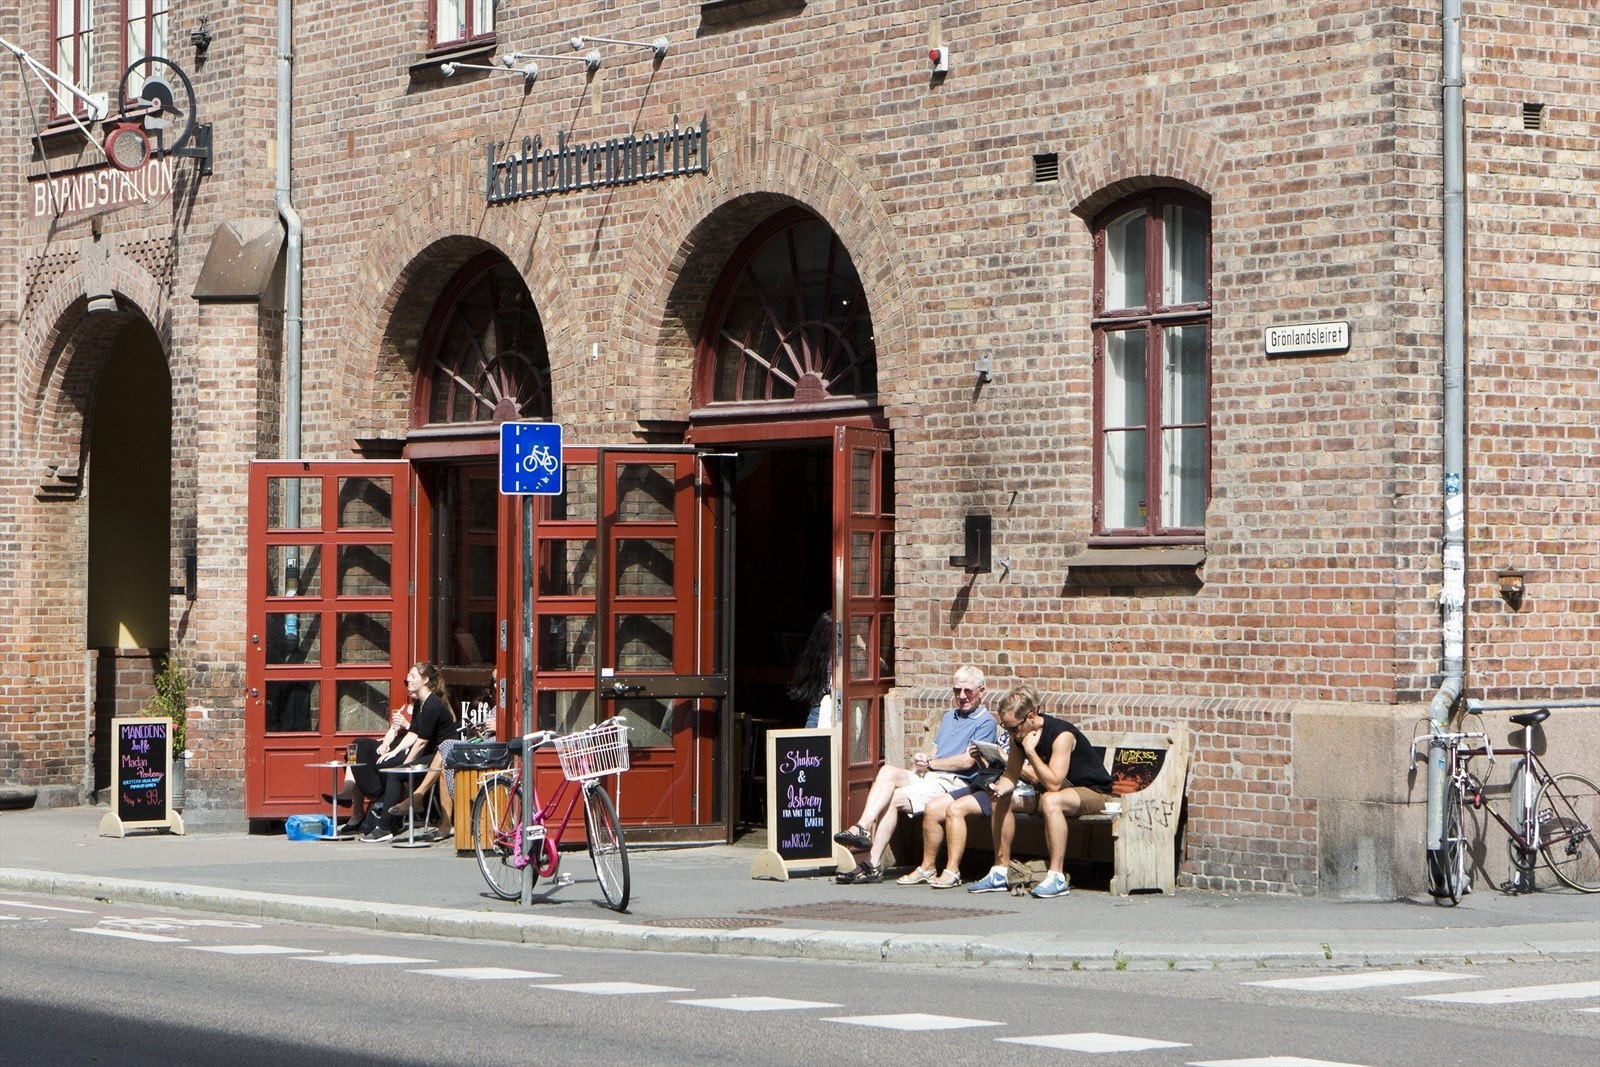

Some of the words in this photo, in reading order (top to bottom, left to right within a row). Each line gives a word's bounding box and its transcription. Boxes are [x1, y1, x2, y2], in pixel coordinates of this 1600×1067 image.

[1271, 327, 1342, 347] Grönlandsleiret
[461, 701, 491, 729] Kaff
[779, 749, 823, 773] Shakes
[797, 770, 806, 783] &
